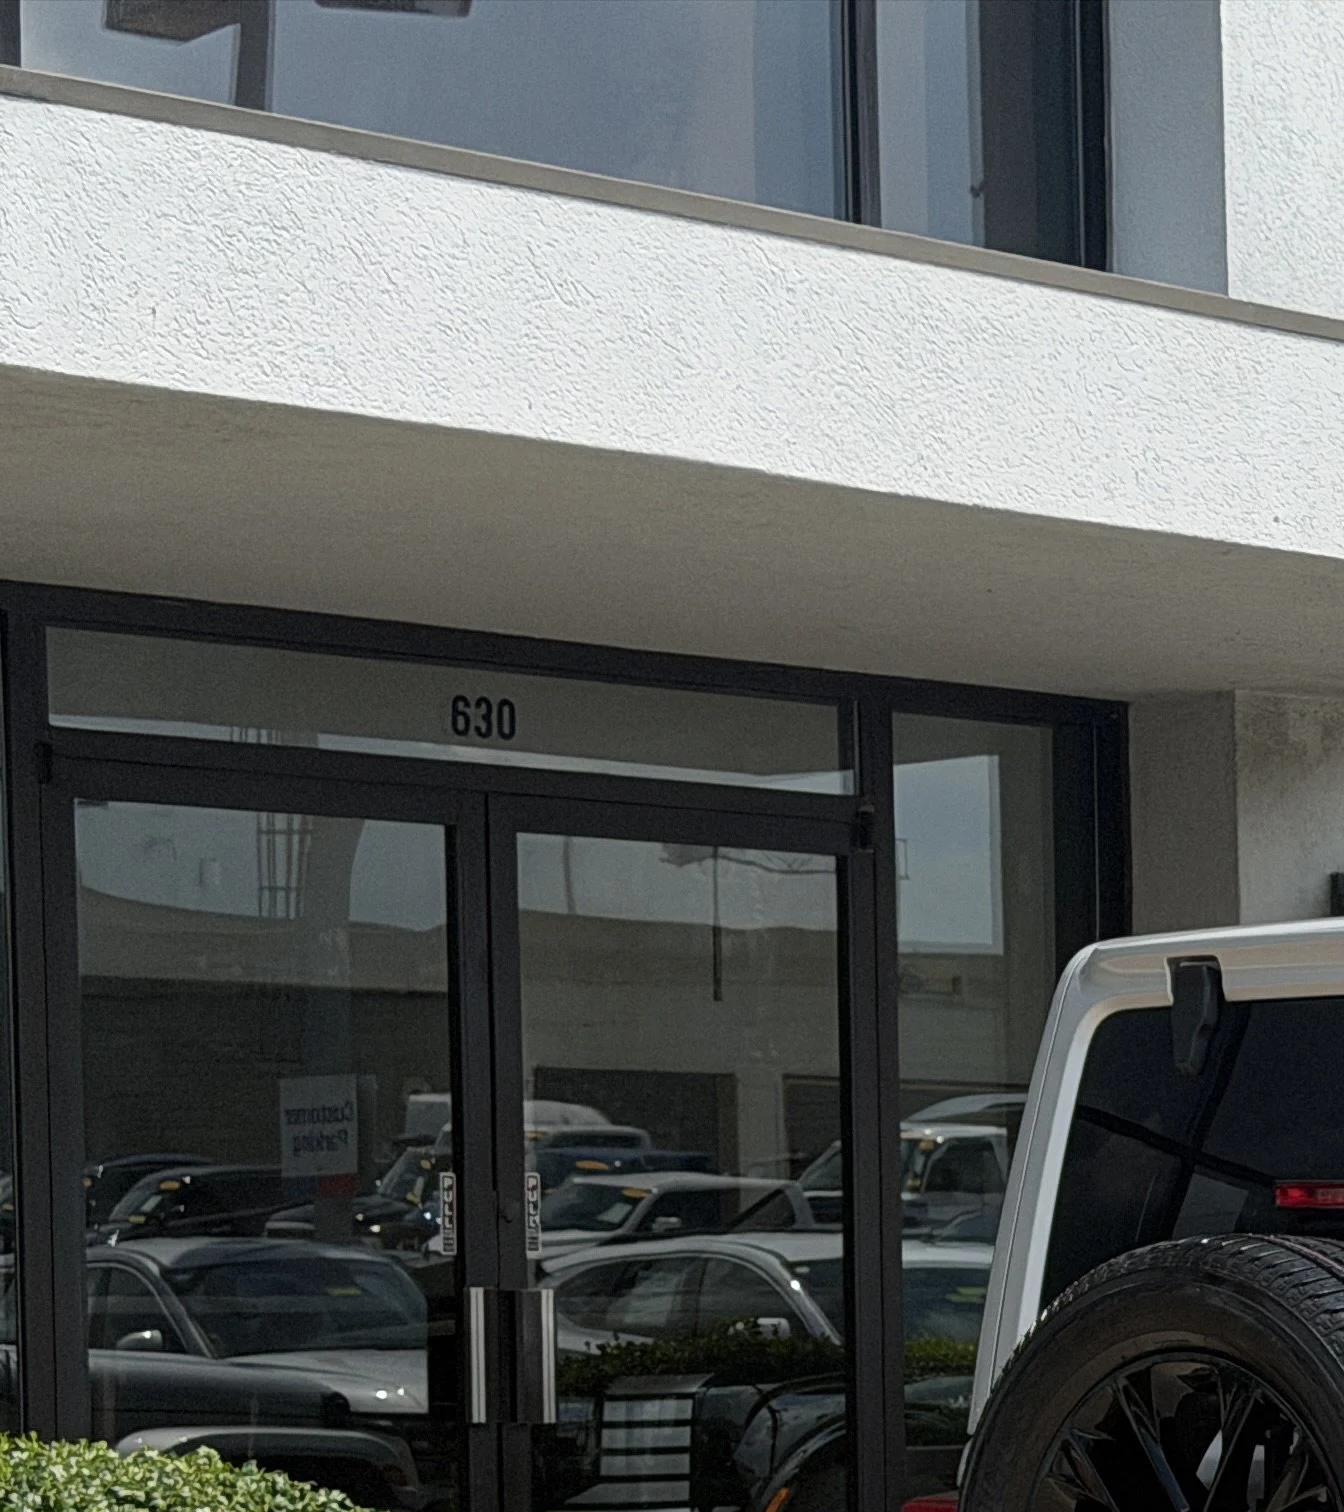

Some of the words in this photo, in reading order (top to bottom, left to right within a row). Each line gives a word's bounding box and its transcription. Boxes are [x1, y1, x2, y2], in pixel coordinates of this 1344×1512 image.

[451, 694, 516, 741] 630
[443, 1176, 453, 1228] PULL
[527, 1177, 538, 1228] PULL
